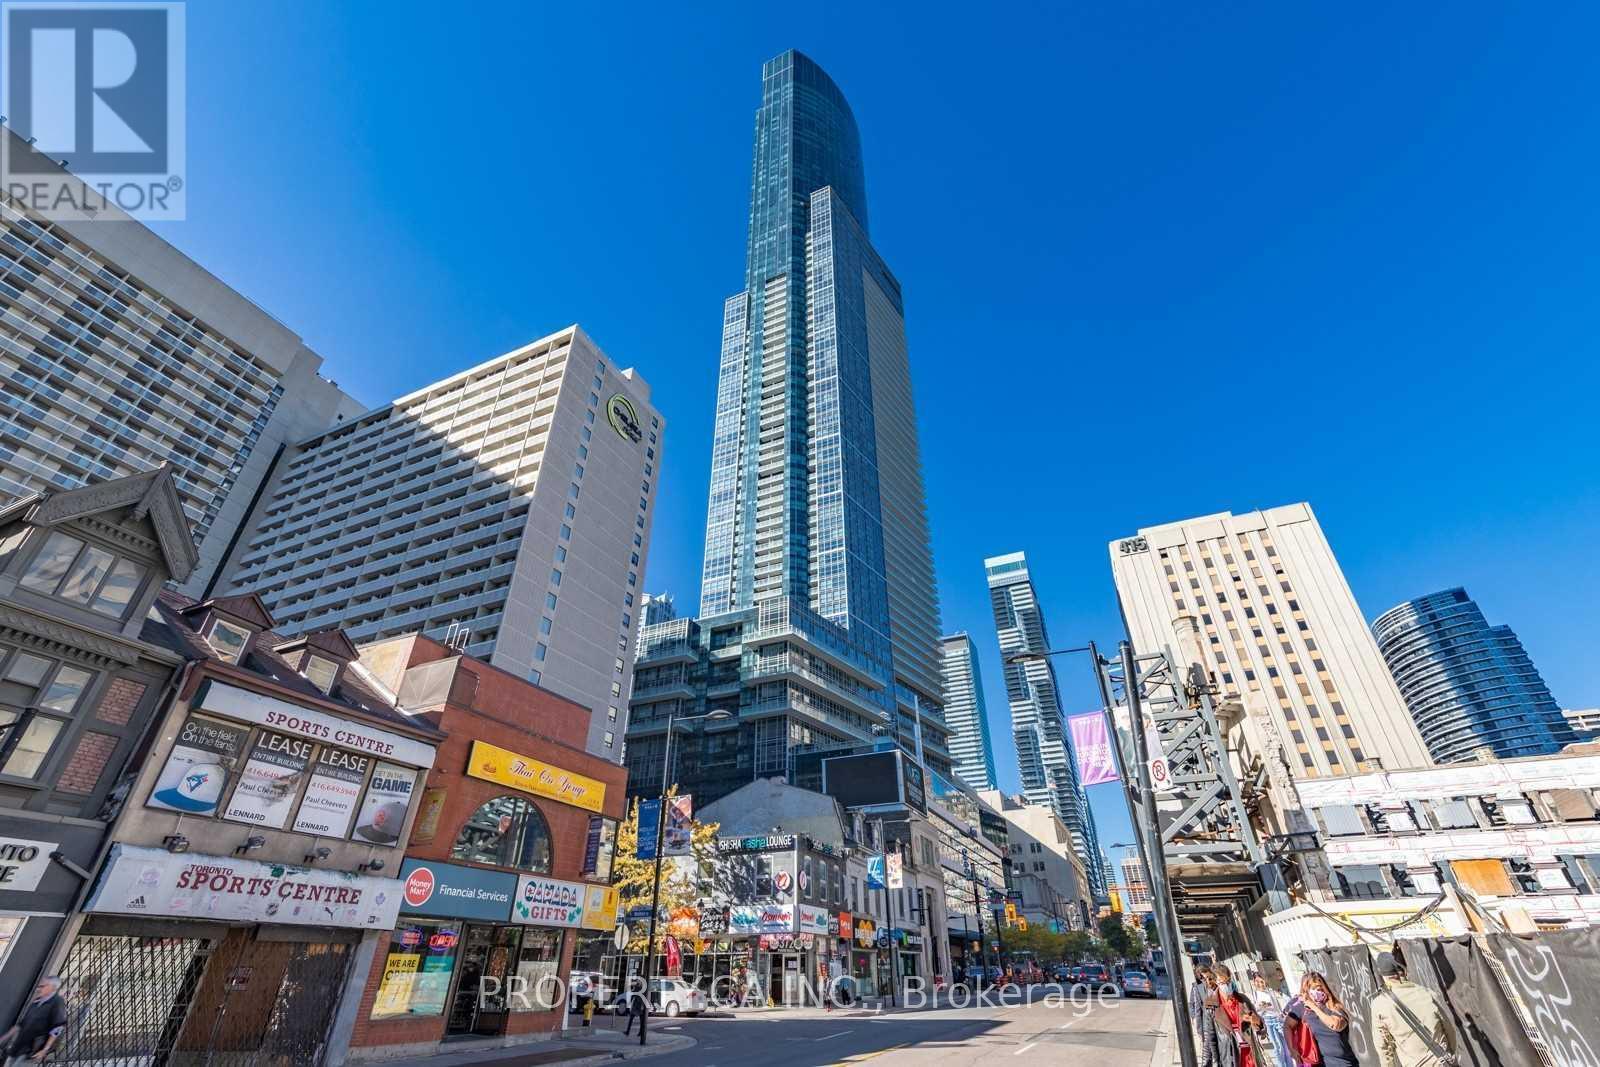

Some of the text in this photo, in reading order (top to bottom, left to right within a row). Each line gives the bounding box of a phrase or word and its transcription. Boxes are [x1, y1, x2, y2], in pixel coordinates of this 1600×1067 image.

[1119, 536, 1148, 554] 415
[265, 711, 394, 756] SPORTS CENTRE
[257, 732, 313, 759] LEASE
[252, 751, 305, 770] ENTIRE BUILDING
[319, 748, 369, 773] LEASE
[316, 766, 337, 777] ENTIRE
[509, 760, 535, 778] Thai
[371, 777, 412, 793] GAME
[305, 795, 320, 804] Paul
[228, 808, 266, 821] LENNARD
[296, 820, 329, 832] LENNARD
[766, 834, 792, 847] LOUNGE
[190, 863, 234, 876] TORONTO
[176, 870, 273, 897] SPORTS
[278, 882, 362, 905] CENTRE
[409, 879, 432, 889] Money
[410, 887, 426, 896] Mart
[440, 884, 509, 902] Financial Services
[524, 880, 577, 907] CANADA
[531, 905, 568, 921] GIFTS
[389, 959, 416, 968] WE ARE
